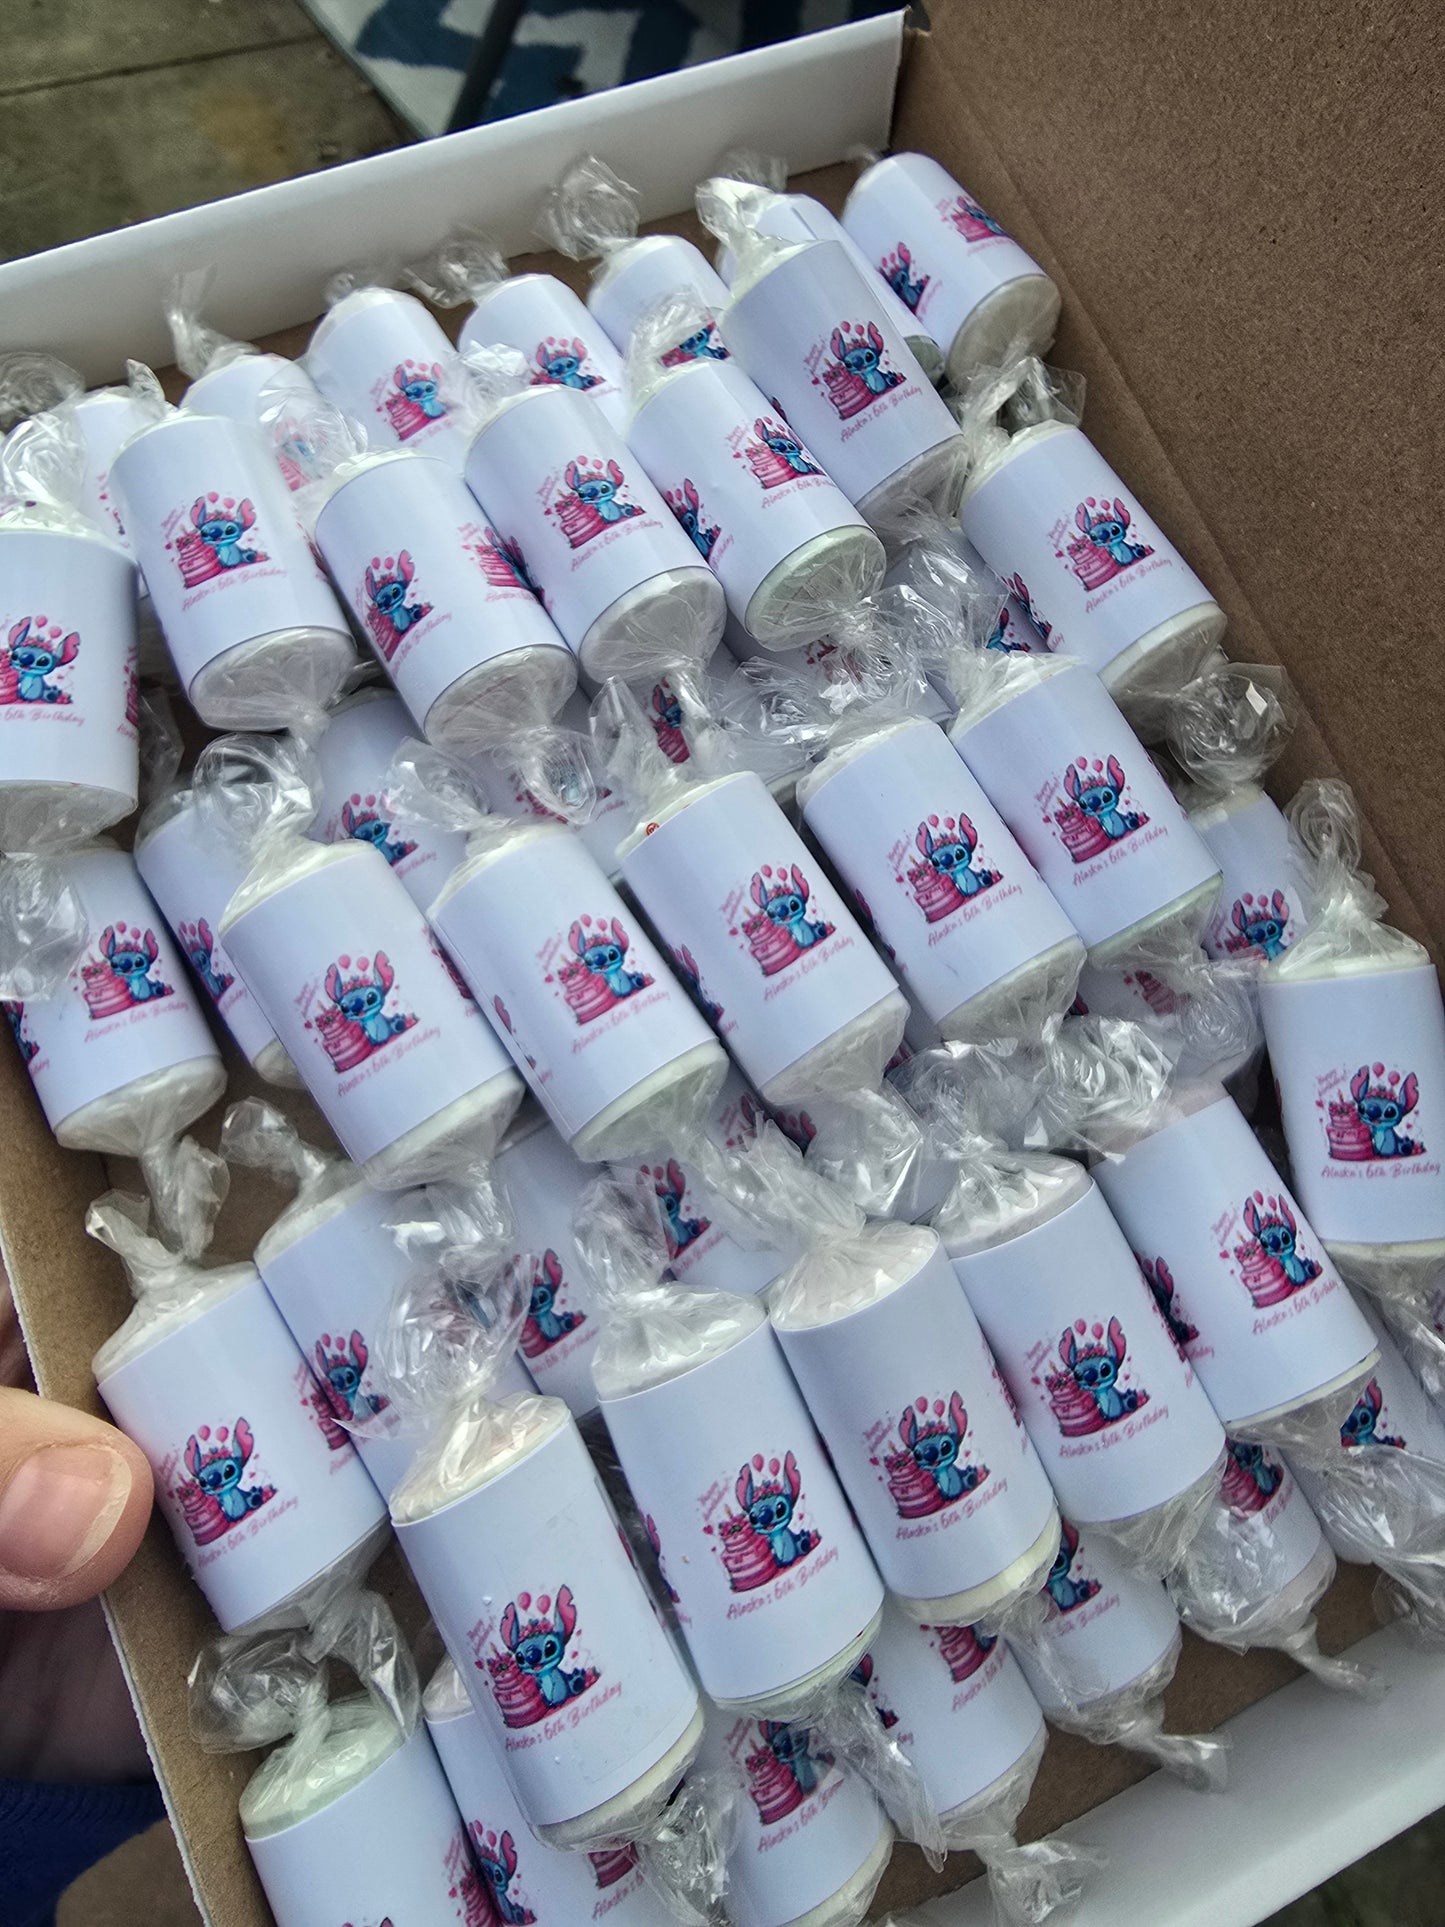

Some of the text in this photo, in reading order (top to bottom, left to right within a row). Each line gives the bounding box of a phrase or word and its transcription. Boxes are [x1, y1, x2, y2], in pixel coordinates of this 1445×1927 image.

[840, 386, 923, 442] Alaska's 6th Birthday
[761, 485, 796, 509] Alaska's
[796, 479, 814, 491] 6th
[571, 519, 664, 572] Alaska's 6th Birthday
[241, 568, 287, 582] Birthday
[1085, 558, 1174, 613] Alaska's 6th Birthday
[4, 708, 85, 727] 6th Birthday
[1073, 825, 1169, 886] Alaska's 6th Birthday
[928, 882, 1024, 947] Alaska's 6th Birthday
[764, 936, 856, 1001] Alaska's 6th Birthday
[84, 1002, 189, 1042] Alaska's 6th Birthday
[572, 991, 671, 1054] Alaska's 6th Birthday
[337, 1027, 441, 1097] Alaska's 6th Birthday
[1321, 1161, 1441, 1179] Alaska's 6th Birthday
[1252, 1306, 1293, 1335] Alaska's
[1292, 1294, 1311, 1313] 6th
[1060, 1404, 1169, 1457] Alaska's 6th Birthday
[227, 1533, 246, 1550] 6th
[247, 1496, 298, 1537] Birthday
[897, 1478, 1008, 1540] Alaska's 6th Birthday
[727, 1545, 839, 1620] Alaska's 6th Birthday
[1079, 1594, 1120, 1629] Birthday
[543, 1720, 565, 1740] 6th
[566, 1681, 622, 1727] Birthday
[952, 1680, 986, 1713] Alaska's
[756, 1822, 799, 1853] Alaska's
[800, 1802, 818, 1826] 6th
